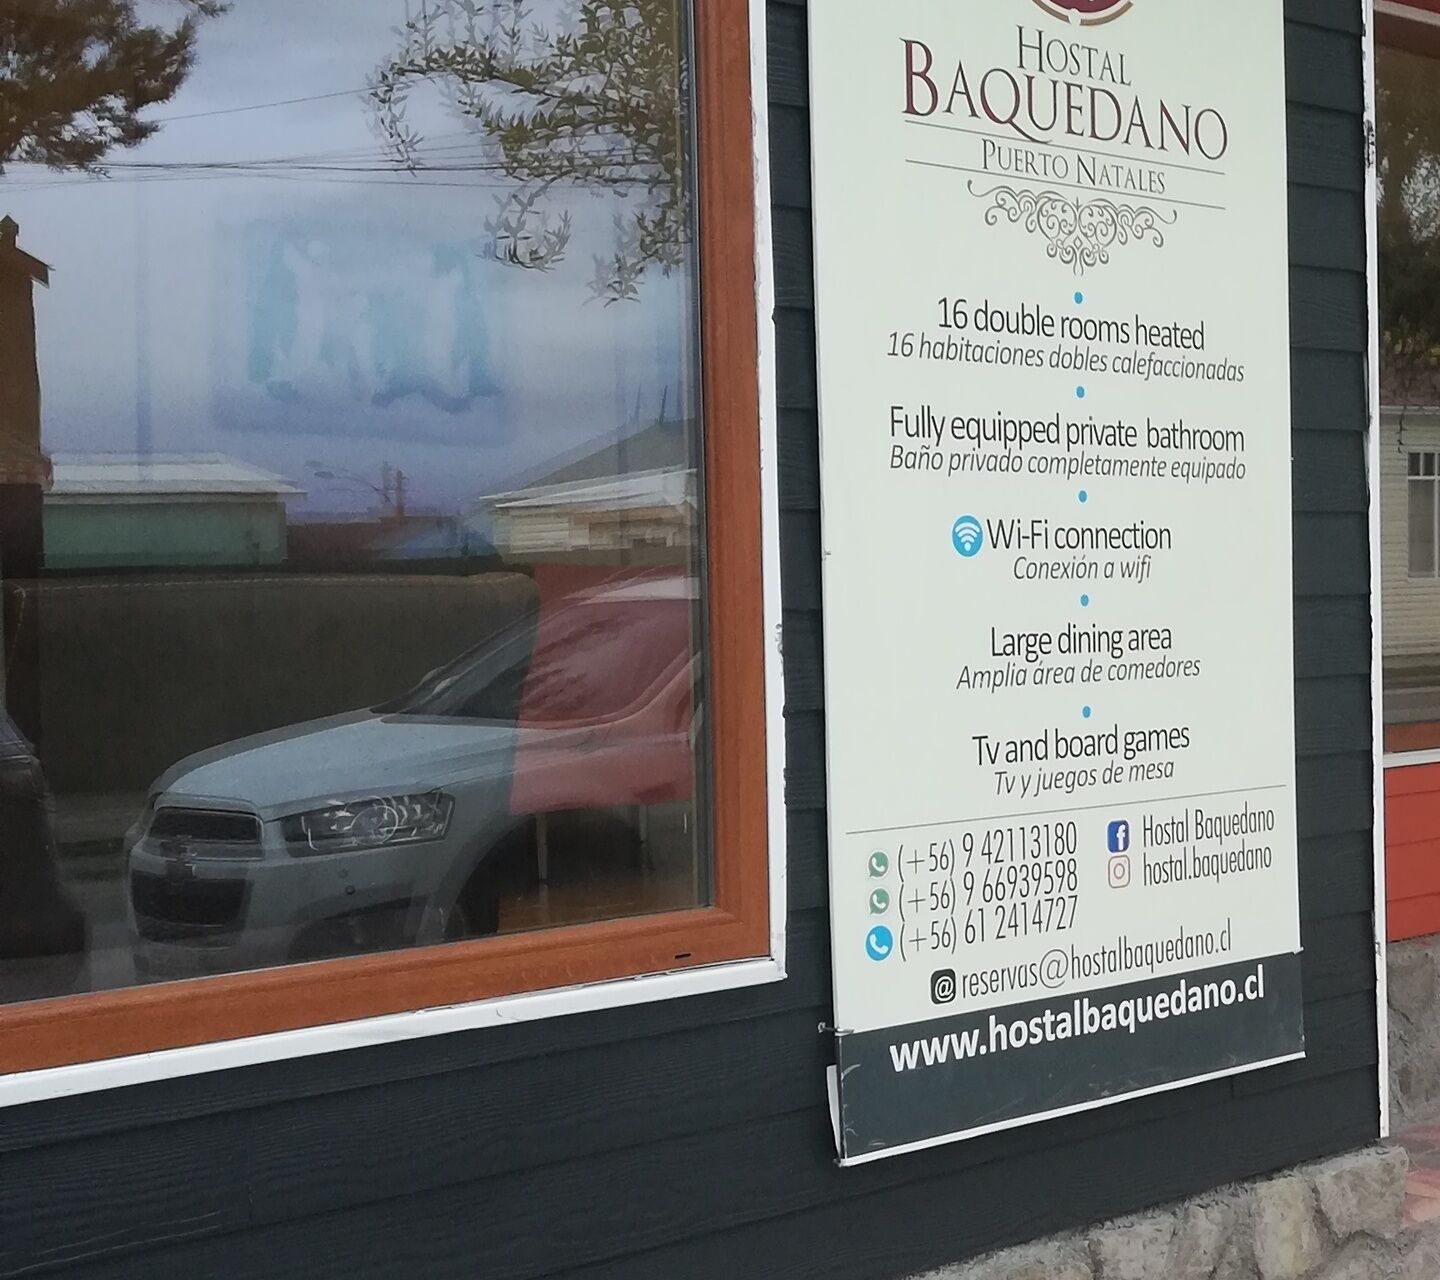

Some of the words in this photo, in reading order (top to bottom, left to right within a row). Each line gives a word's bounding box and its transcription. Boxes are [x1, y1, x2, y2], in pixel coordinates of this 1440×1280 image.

[938, 297, 967, 328] 16
[974, 299, 1055, 337] double
[1060, 316, 1130, 344] rooms
[1136, 315, 1205, 350] heated
[887, 332, 914, 358] 16
[919, 333, 1044, 368] habitaciones
[1049, 345, 1108, 372] dobles
[1112, 350, 1244, 382] calefaccionadas
[890, 405, 945, 447] Fully
[950, 411, 1060, 450] equipped
[1066, 415, 1138, 452] private
[1147, 417, 1245, 452] bathroom
[890, 445, 943, 471] Baño
[947, 448, 1023, 476] privado
[1028, 450, 1166, 481] completamente
[1170, 457, 1246, 484] equipado
[987, 518, 1049, 550] Wi-Fi
[1054, 521, 1172, 550] connection
[1013, 553, 1099, 580] Conexión
[1103, 562, 1115, 579] a
[1120, 555, 1151, 583] wifi
[991, 626, 1052, 662] Large
[1058, 623, 1123, 658] dining
[1128, 626, 1172, 651] area
[956, 661, 1028, 694] Amplia
[1032, 660, 1075, 685] área
[1080, 659, 1103, 683] de
[1107, 655, 1201, 682] comedores
[972, 736, 1000, 766] Tv
[1005, 729, 1048, 762] and
[1055, 723, 1118, 760] board
[1123, 726, 1190, 760] games
[995, 771, 1016, 795] Tv
[1020, 773, 1032, 798] y
[1033, 765, 1097, 798] juegos
[1102, 761, 1124, 784] de
[1128, 760, 1174, 782] mesa
[1143, 808, 1190, 847] Hostal
[1195, 801, 1274, 845] Baquedano
[898, 838, 956, 882] (+56)
[962, 833, 974, 867] 9
[981, 821, 1077, 863] 42113180
[1143, 838, 1272, 887] hostal.baquedano
[899, 877, 956, 921] (+56)
[963, 872, 975, 906] 9
[981, 859, 1078, 903] 66939598
[899, 917, 957, 961] (+56)
[964, 908, 986, 944] 61
[995, 895, 1078, 941] 2414727
[962, 918, 1232, 999] reservas@hostalbaquedano.cl
[889, 964, 1265, 1072] www.hostalbaquedano.cl
